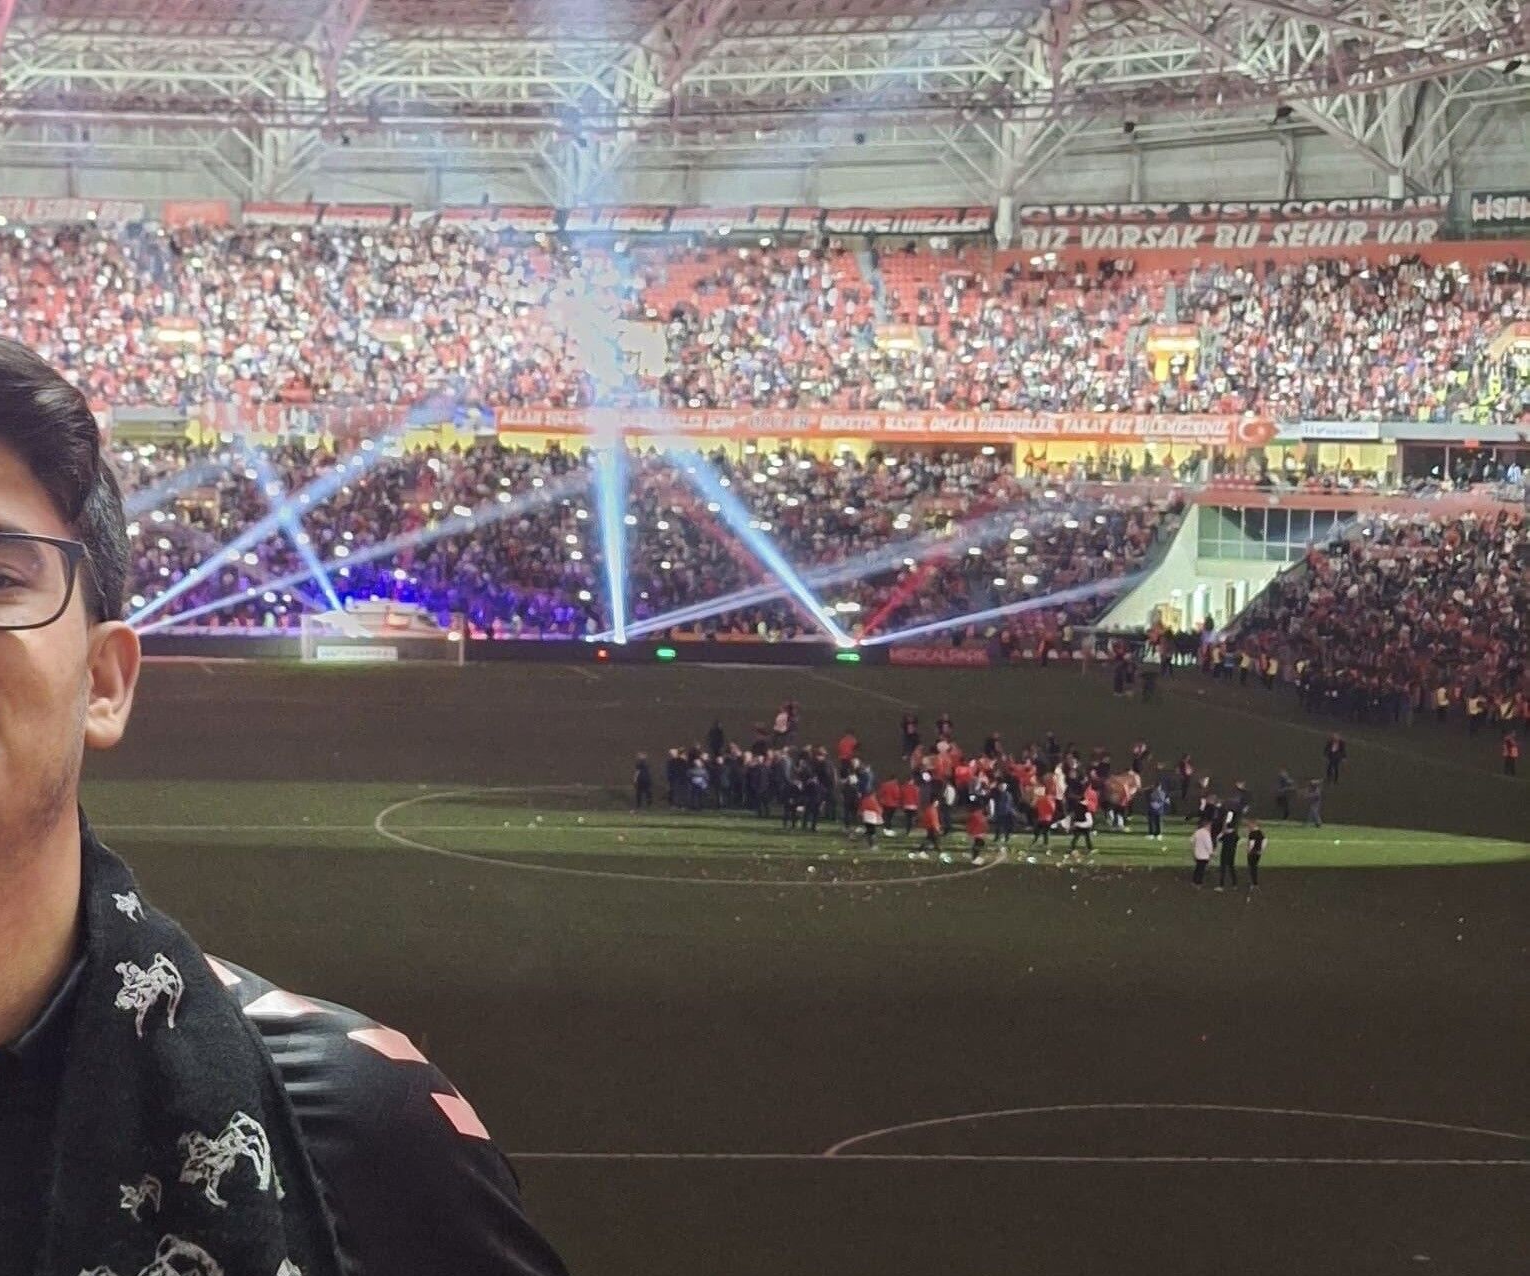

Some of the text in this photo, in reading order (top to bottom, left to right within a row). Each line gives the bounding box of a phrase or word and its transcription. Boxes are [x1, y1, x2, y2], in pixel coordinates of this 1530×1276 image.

[1081, 224, 1205, 249] VARSAK
[1214, 223, 1260, 249] BU
[1377, 217, 1439, 245] VAR
